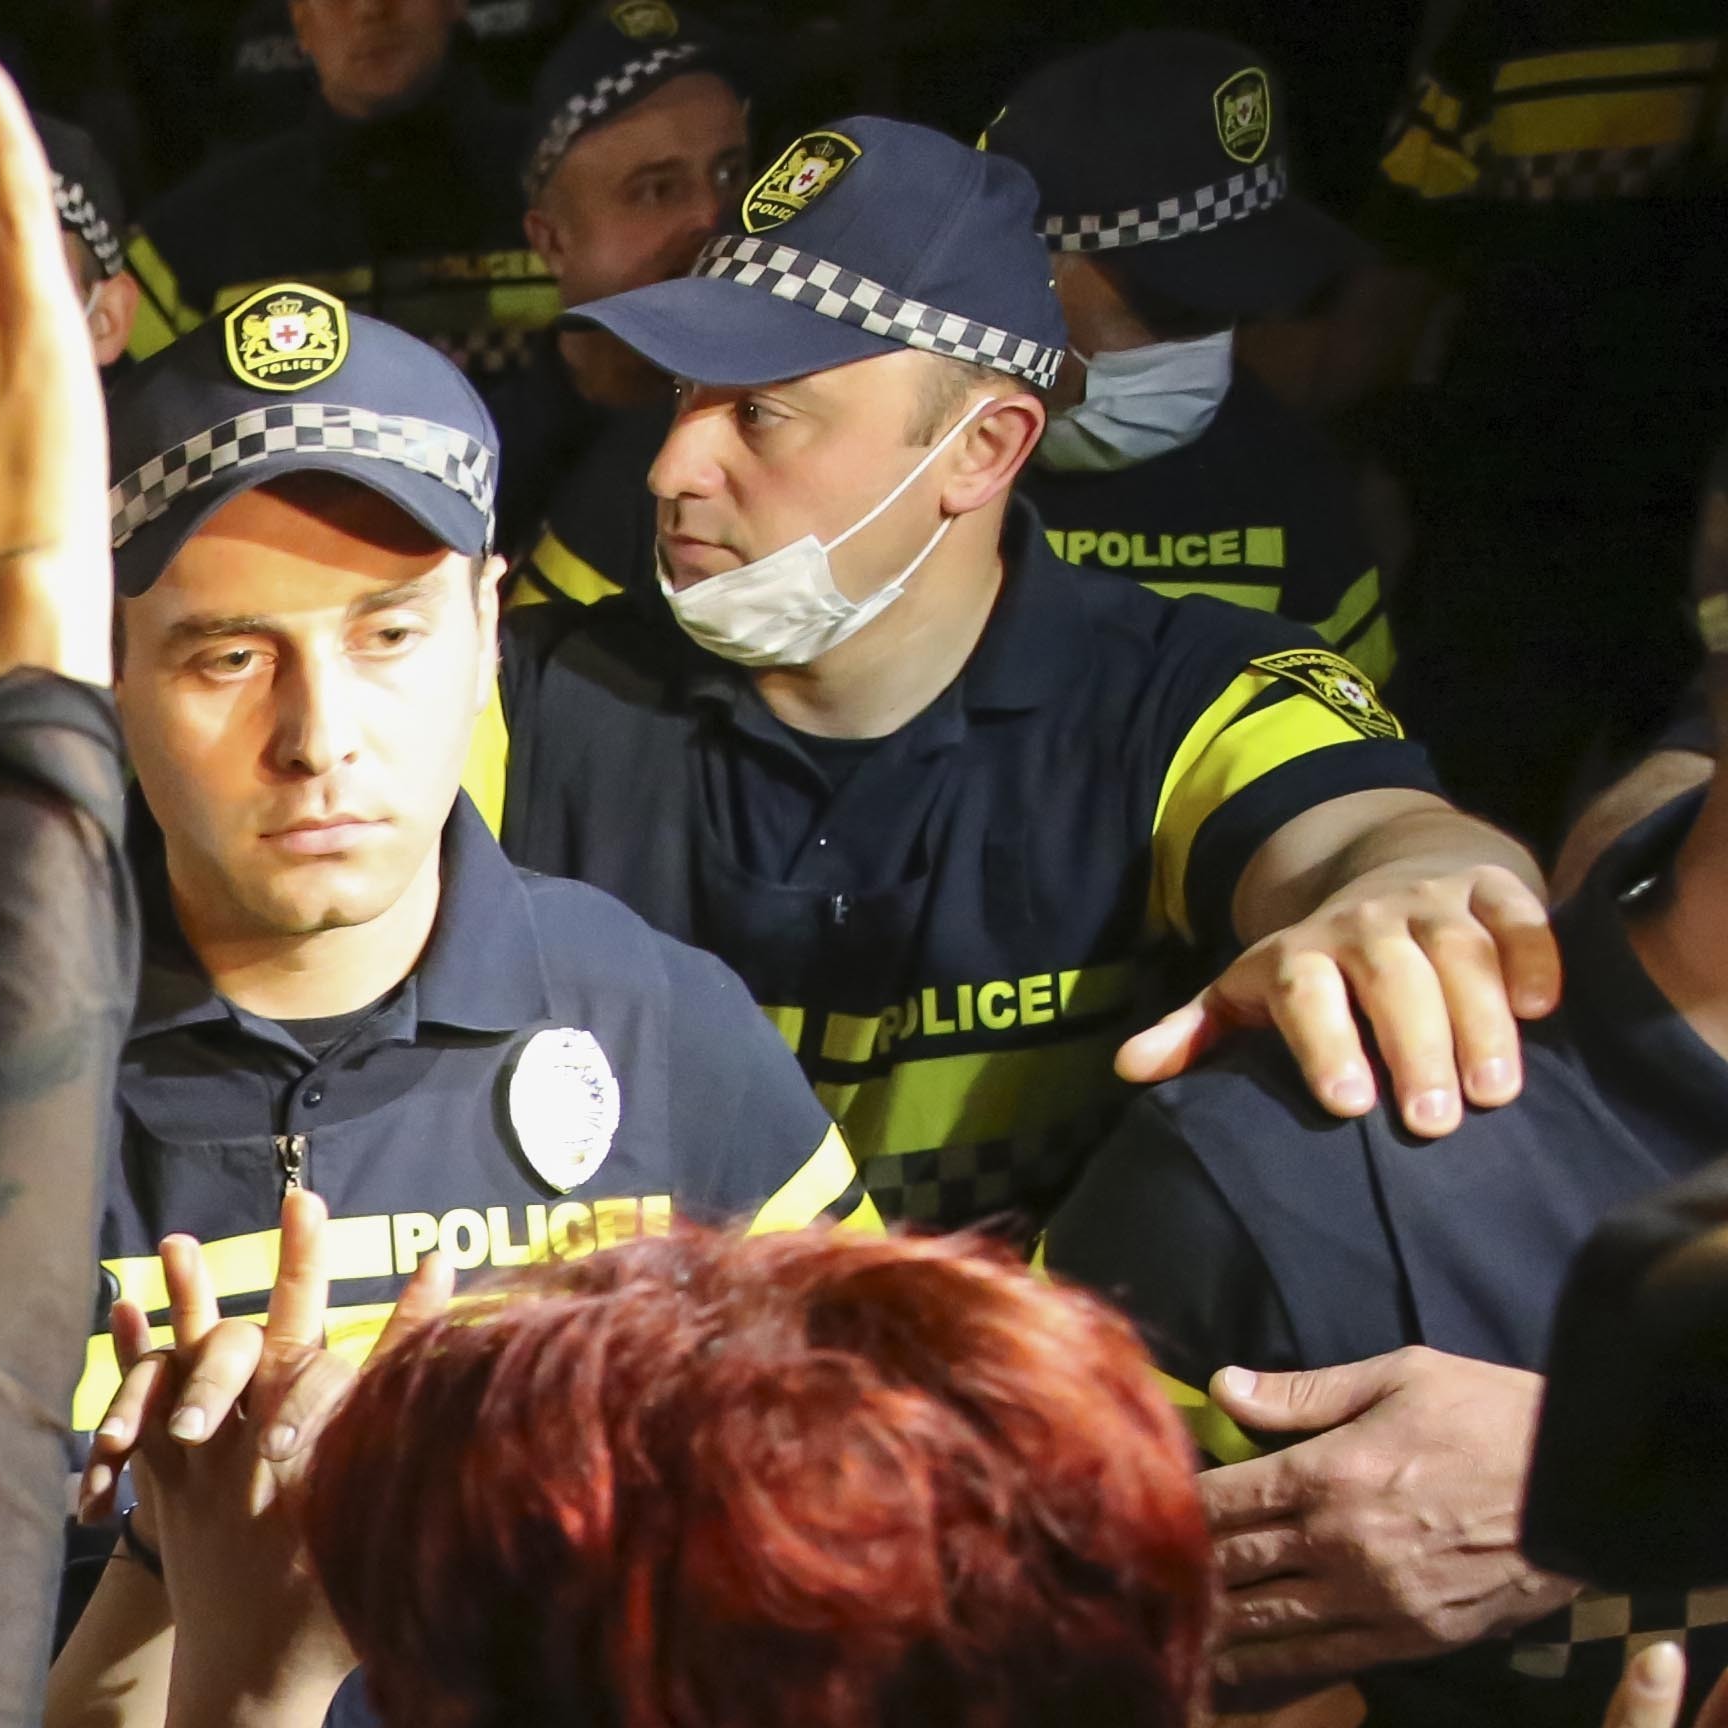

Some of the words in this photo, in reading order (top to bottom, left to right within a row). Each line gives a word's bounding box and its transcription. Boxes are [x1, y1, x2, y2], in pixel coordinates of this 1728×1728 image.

[258, 359, 323, 378] POLICE
[1066, 529, 1241, 567] POLICE
[394, 1197, 637, 1276] POLICE
